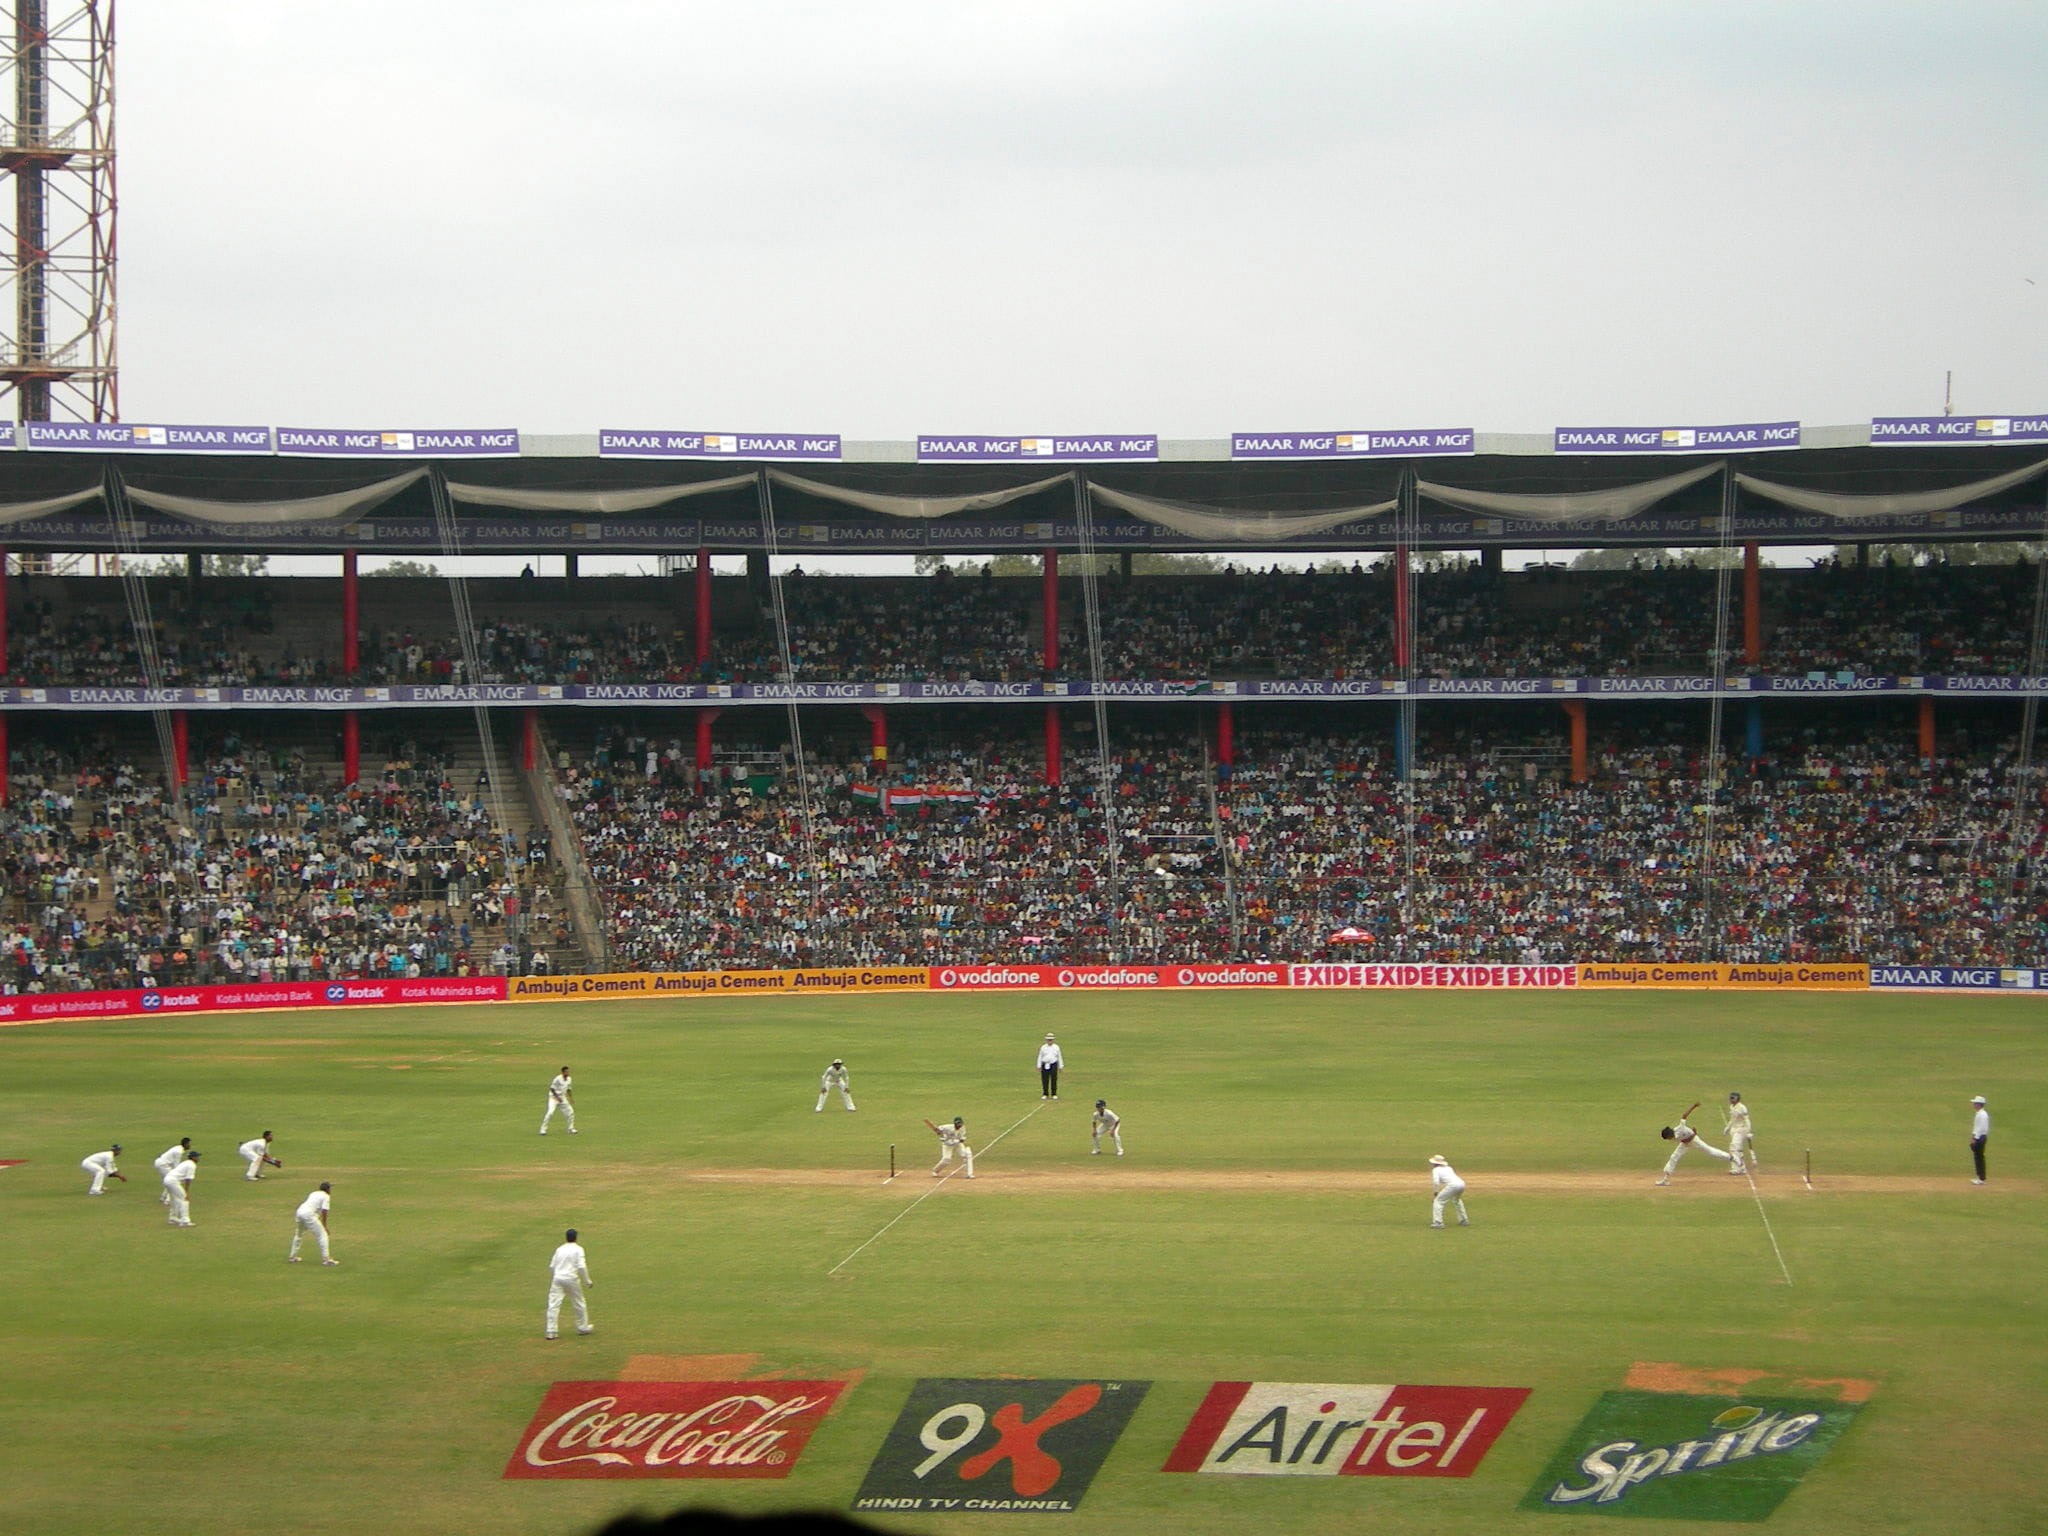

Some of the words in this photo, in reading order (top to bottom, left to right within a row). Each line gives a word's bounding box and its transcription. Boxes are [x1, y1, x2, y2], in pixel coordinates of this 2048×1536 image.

[31, 428, 91, 441] EMAAR
[96, 429, 131, 441] MGF
[1872, 424, 1931, 435] EMAAR
[1937, 422, 1973, 434] MGF
[169, 431, 227, 443] EMAAR
[233, 432, 267, 444] MGF
[280, 432, 339, 446] EMAAR
[344, 435, 380, 447] MGF
[416, 435, 475, 447] EMAAR
[480, 434, 515, 446] MGF
[1372, 436, 1430, 448] EMAAR
[1436, 435, 1470, 446] MGF
[1558, 433, 1617, 445] EMAAR
[1624, 433, 1659, 444] MGF
[1698, 430, 1757, 443] EMAAR
[1763, 428, 1799, 440] MGF
[603, 436, 661, 447] EMAAR
[667, 437, 701, 449] MGF
[739, 439, 797, 450] EMAAR
[803, 440, 838, 451] MGF
[920, 441, 978, 453] EMAAR
[984, 441, 1018, 453] MGF
[1056, 441, 1114, 452] EMAAR
[1120, 440, 1154, 451] MGF
[1235, 439, 1293, 450] EMAAR
[1299, 438, 1334, 450] MGF
[1734, 519, 1787, 529] EMAAR
[1794, 517, 1825, 527] MGF
[1895, 516, 1926, 526] MGF
[1964, 513, 2017, 524] EMAAR
[20, 523, 74, 534] EMAAR
[150, 524, 204, 536] EMAAR
[704, 526, 758, 537] EMAAR
[1114, 526, 1146, 537] MGF
[1341, 525, 1374, 535] MGF
[1439, 523, 1470, 534] MGF
[1507, 521, 1560, 532] EMAAR
[1606, 520, 1659, 531] EMAAR
[1666, 520, 1697, 530] MGF
[378, 527, 431, 537] EMAAR
[476, 527, 530, 537] EMAAR
[537, 527, 569, 537] MGF
[604, 526, 657, 537] EMAAR
[664, 527, 696, 538] MGF
[832, 528, 885, 539] EMAAR
[891, 528, 923, 539] MGF
[930, 527, 983, 538] EMAAR
[989, 526, 1021, 537] MGF
[1091, 683, 1155, 694] EMAAR
[1260, 682, 1324, 694] EMAAR
[1331, 682, 1370, 694] MGF
[1429, 681, 1494, 693] EMAAR
[1501, 680, 1540, 692] MGF
[1600, 679, 1666, 691] EMAAR
[1673, 679, 1713, 691] MGF
[1773, 678, 1839, 690] EMAAR
[1947, 677, 2012, 689] EMAAR
[242, 689, 307, 701] EMAAR
[315, 689, 353, 701] MGF
[486, 687, 525, 699] MGF
[586, 686, 650, 698] EMAAR
[657, 686, 696, 698] MGF
[754, 685, 818, 697] EMAAR
[825, 685, 863, 696] MGF
[993, 684, 1032, 695] MGF
[70, 690, 136, 702] EMAAR
[144, 690, 182, 702] MGF
[794, 973, 856, 987] Ambuja
[862, 972, 925, 985] Cement
[960, 970, 1040, 984] vodafone
[1077, 970, 1158, 984] vodafone
[1198, 968, 1278, 983] vodafone
[1293, 967, 1362, 985] EXIDE
[1365, 967, 1434, 986] EXIDE
[1435, 967, 1504, 986] EXIDE
[1507, 967, 1576, 986] EXIDE
[1583, 968, 1647, 982] Ambuja
[1652, 968, 1717, 981] Cement
[1729, 968, 1793, 983] Ambuja
[1798, 968, 1864, 982] Cement
[1870, 970, 1945, 984] EMAAR
[1952, 971, 1995, 985] MGF
[516, 980, 577, 995] Ambuja
[582, 978, 646, 992] Cement
[654, 976, 716, 991] Ambuja
[721, 975, 784, 988] Cement
[348, 987, 383, 998] kotak
[402, 987, 427, 997] Kotak
[430, 986, 472, 997] Mahindra
[475, 985, 497, 995] Bank
[164, 995, 199, 1006] kotak
[216, 994, 242, 1004] Kotak
[244, 992, 286, 1003] Mahindra
[289, 991, 312, 1001] Bank
[32, 1004, 58, 1014] Kotak
[60, 1002, 103, 1013] Mahindra
[105, 1000, 127, 1010] Bank
[1215, 1401, 1488, 1468] Airtel
[1551, 1411, 1821, 1502] Sprite
[857, 1498, 922, 1509] HINDI
[929, 1499, 960, 1509] TV
[964, 1499, 1073, 1510] CHANNEL
